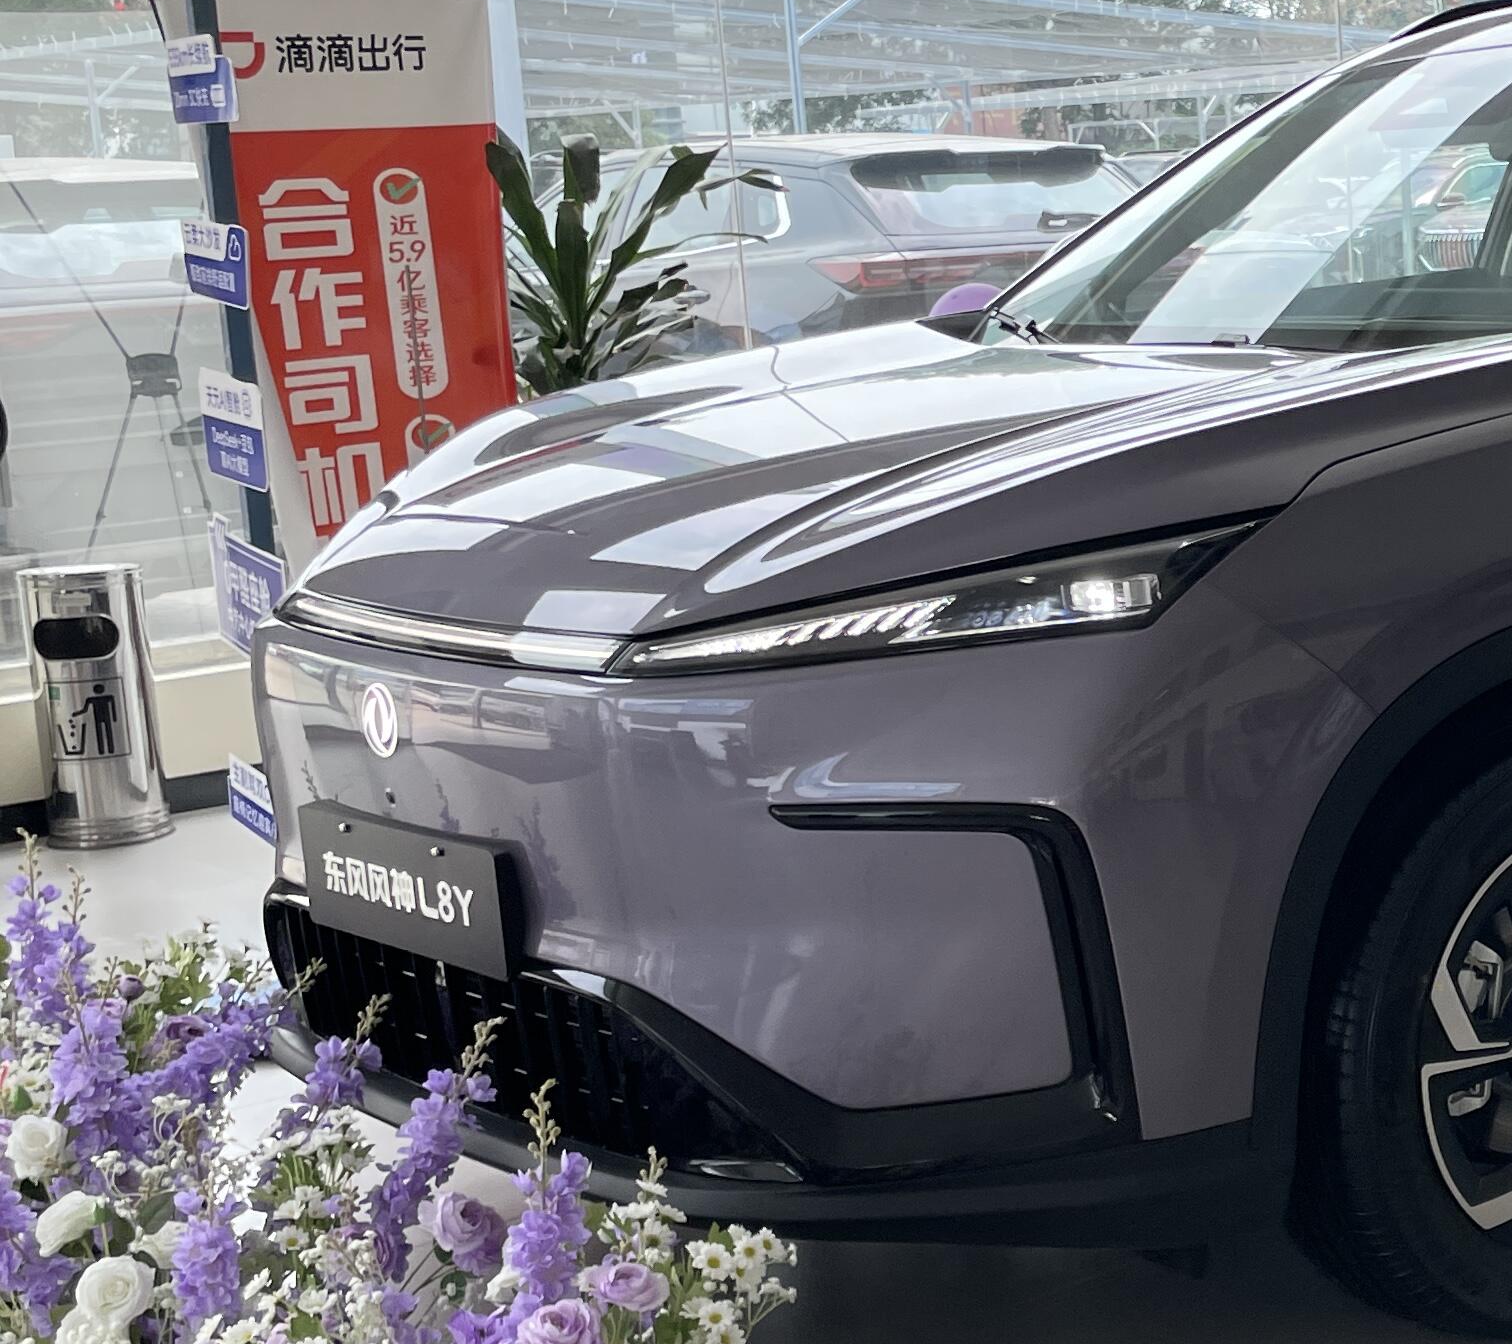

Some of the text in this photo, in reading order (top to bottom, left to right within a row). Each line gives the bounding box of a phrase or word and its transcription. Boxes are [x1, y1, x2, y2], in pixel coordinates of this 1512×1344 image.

[275, 33, 427, 74] 滴滴出行
[258, 177, 386, 527] 合作司机
[322, 851, 474, 927] 东风风神L8Y
